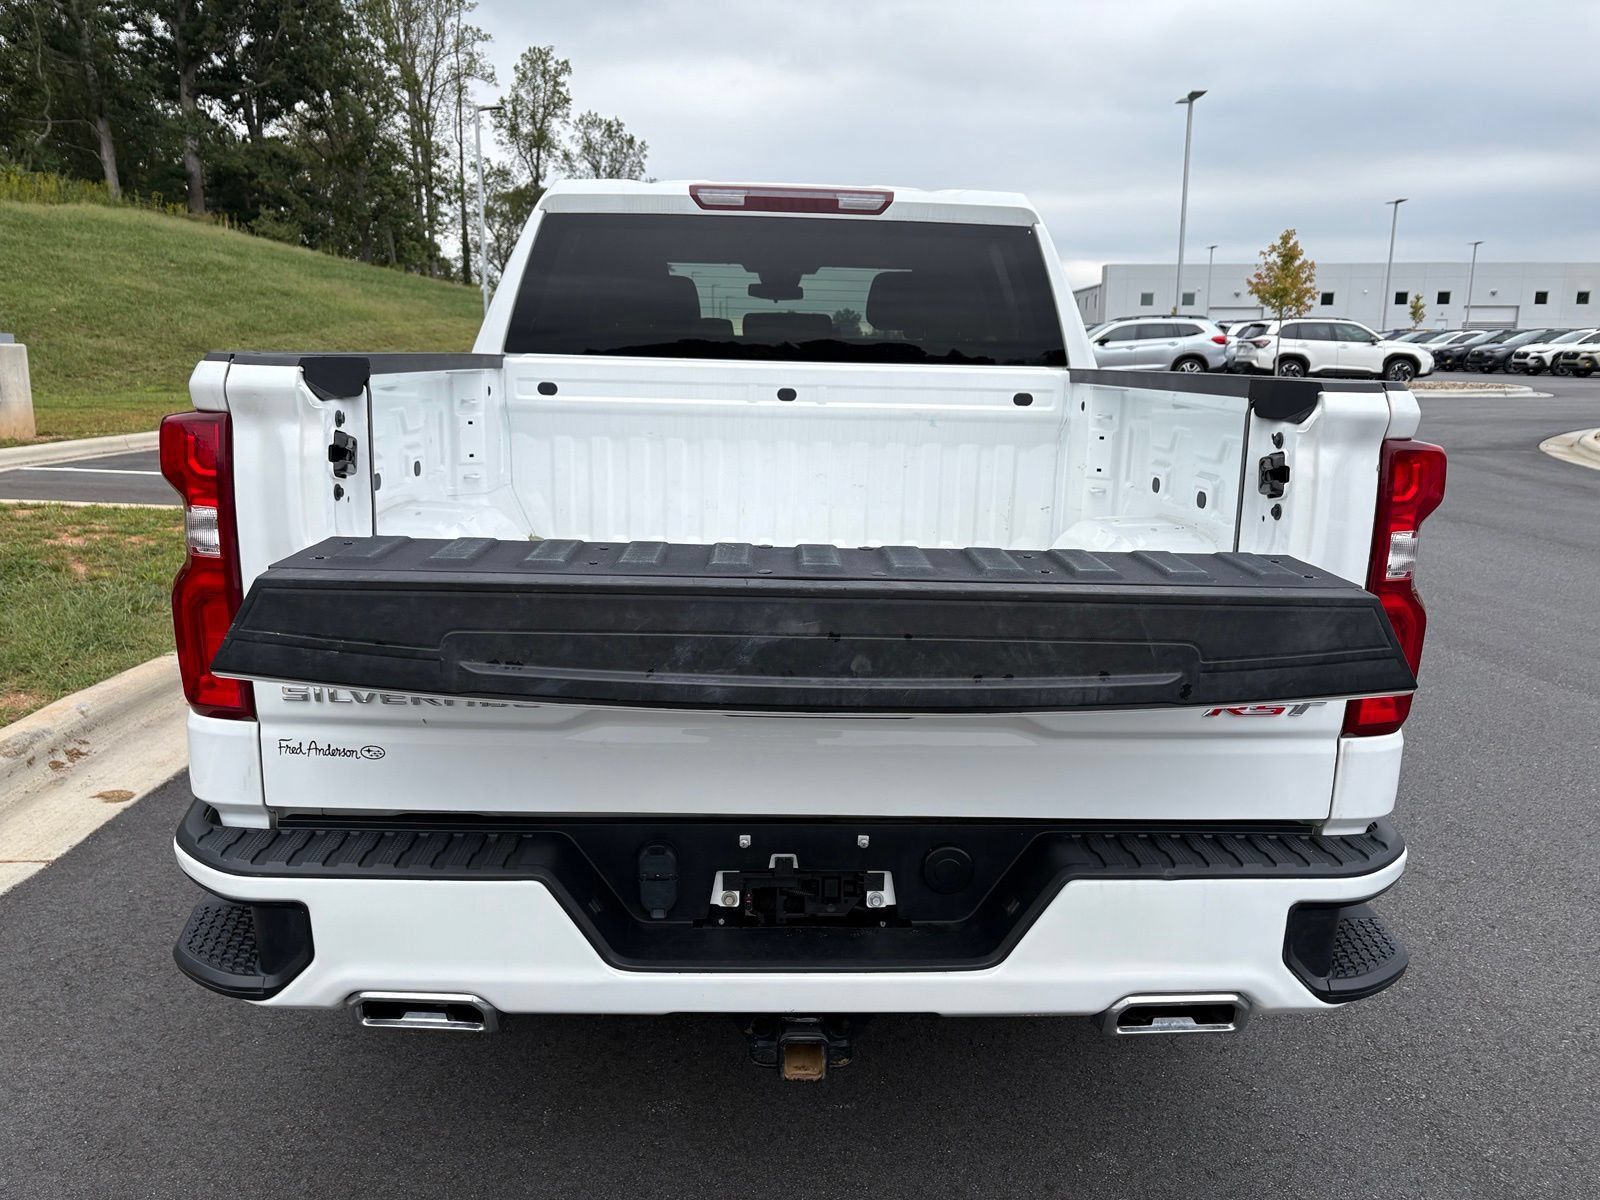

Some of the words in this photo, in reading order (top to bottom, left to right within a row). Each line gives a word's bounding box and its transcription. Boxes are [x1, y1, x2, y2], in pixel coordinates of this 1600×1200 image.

[282, 685, 541, 708] SILVER
[278, 738, 306, 757] Fred
[307, 740, 361, 761] Anderson
